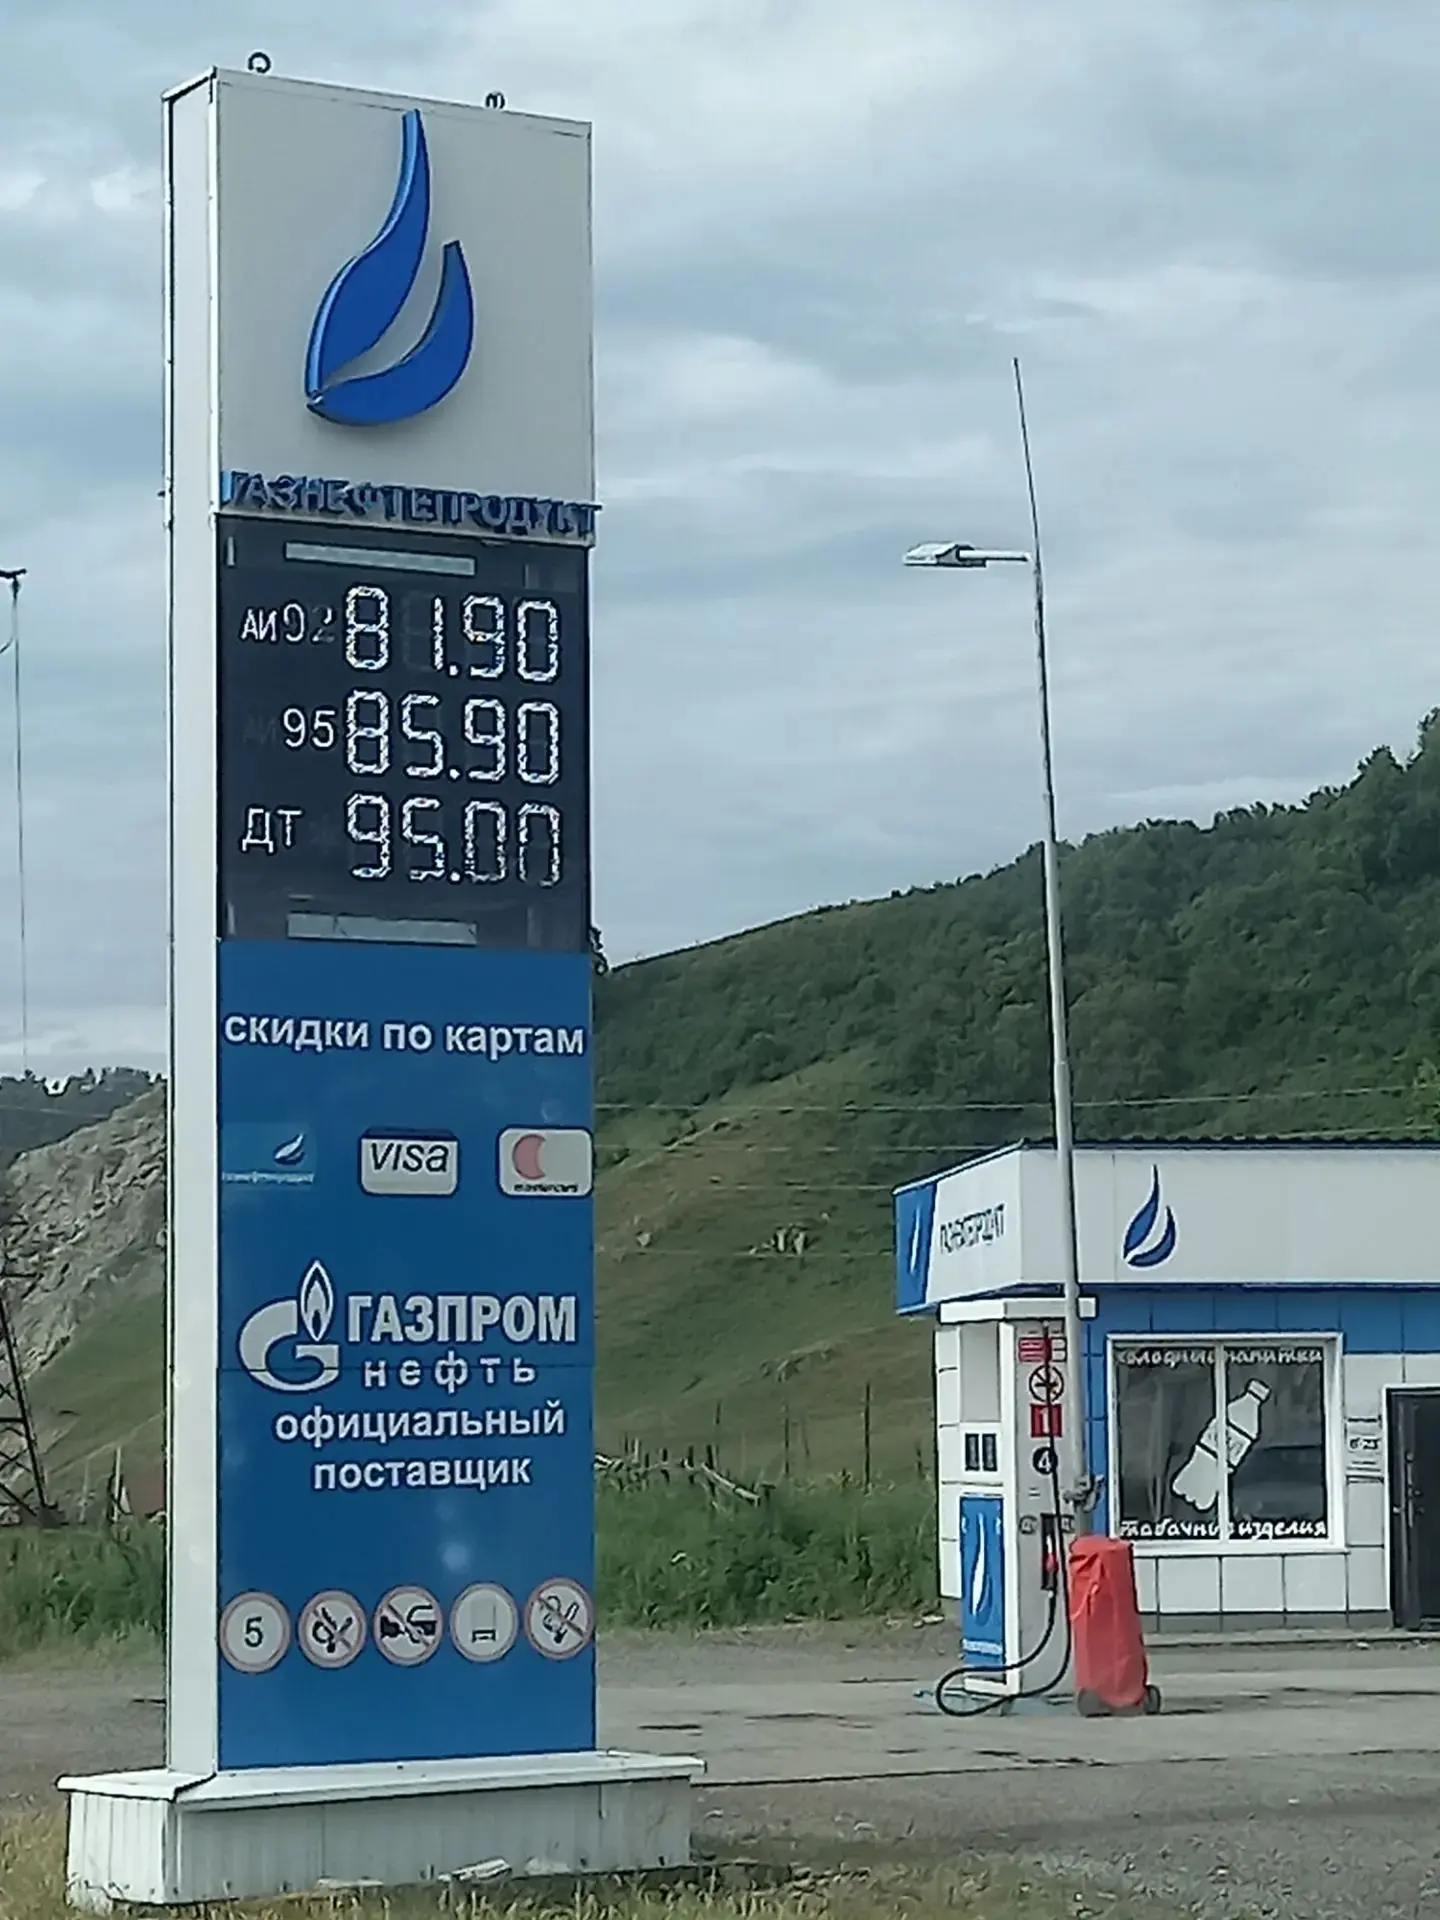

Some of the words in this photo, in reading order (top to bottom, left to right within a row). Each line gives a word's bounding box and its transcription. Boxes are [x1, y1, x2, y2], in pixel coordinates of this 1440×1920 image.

[345, 585, 559, 682] 81.90
[283, 708, 335, 747] 95
[346, 690, 560, 783] 85.90
[241, 808, 302, 853] ДТ
[224, 1015, 369, 1052] скидки
[383, 1024, 432, 1051] по
[446, 1024, 584, 1060] картам
[347, 1295, 576, 1342] ГАЗПРОМ
[364, 1350, 536, 1393] нефть
[275, 1399, 565, 1447] официальный
[1039, 1407, 1051, 1434] 1
[313, 1457, 531, 1490] поставщик
[1037, 1454, 1050, 1473] 4
[1238, 1520, 1327, 1540] изделия
[244, 1617, 264, 1647] 5
